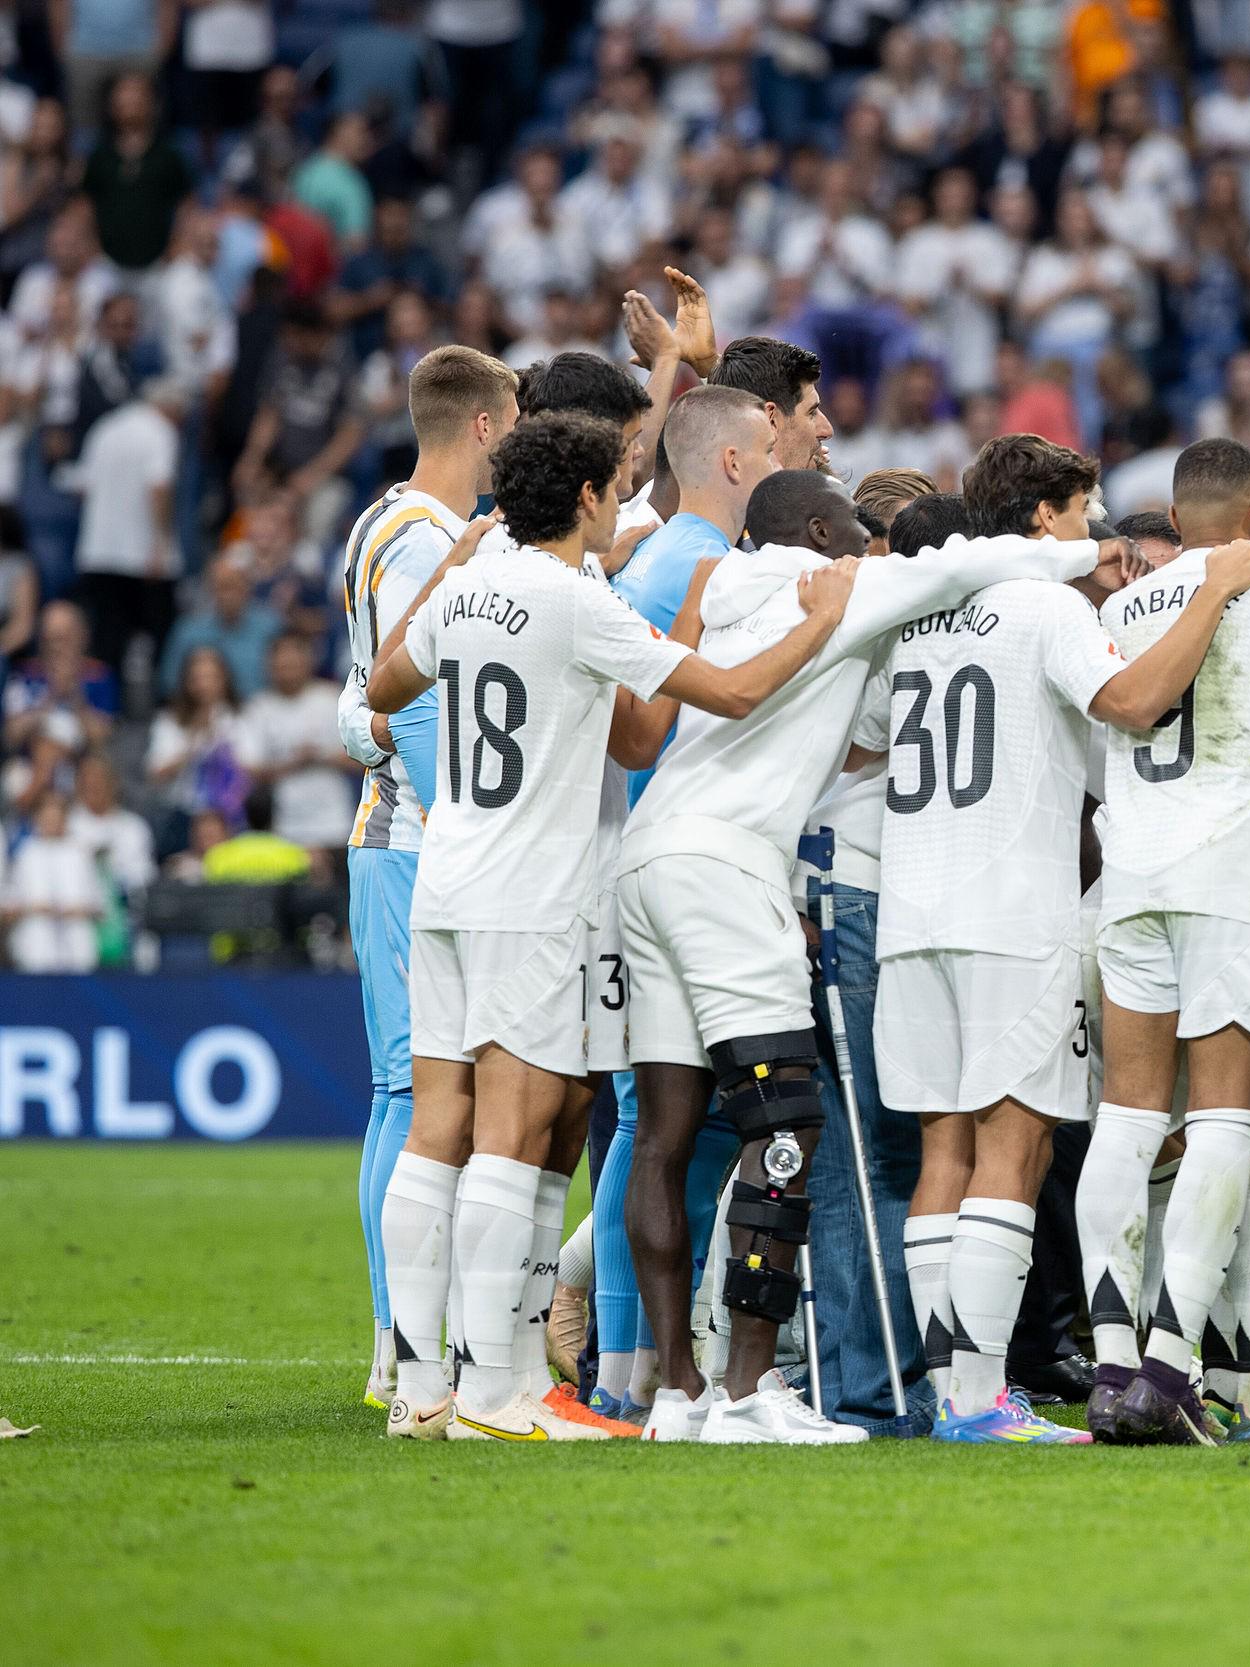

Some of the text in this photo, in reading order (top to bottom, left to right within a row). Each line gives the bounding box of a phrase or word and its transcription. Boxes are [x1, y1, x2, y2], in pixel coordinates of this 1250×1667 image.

[443, 592, 529, 635] VALLEJO
[1123, 585, 1239, 626] MBA
[438, 658, 528, 809] 18
[886, 663, 996, 815] 30
